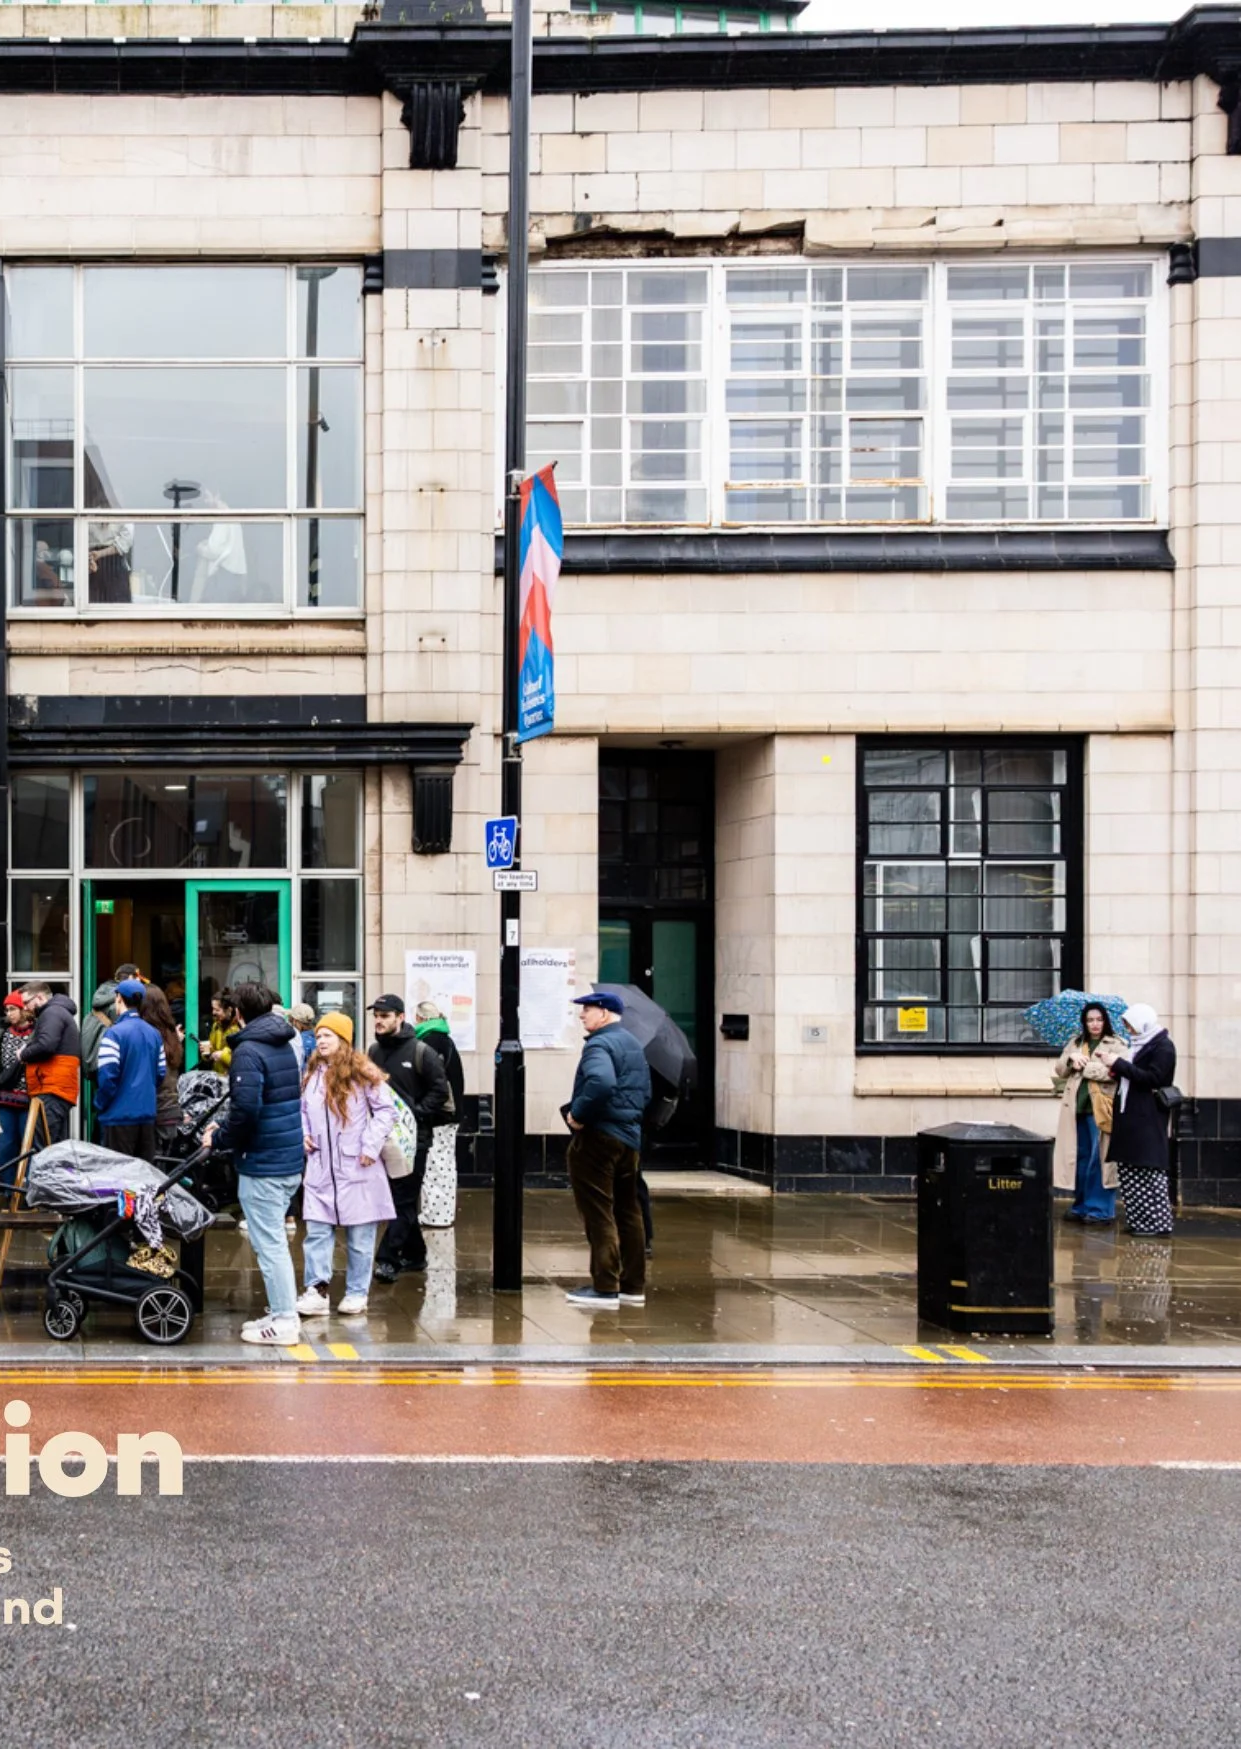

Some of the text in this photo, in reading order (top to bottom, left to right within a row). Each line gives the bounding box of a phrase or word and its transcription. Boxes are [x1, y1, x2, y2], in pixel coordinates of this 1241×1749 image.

[509, 930, 516, 941] 7
[440, 954, 465, 963] spring
[988, 1177, 1024, 1190] Litter
